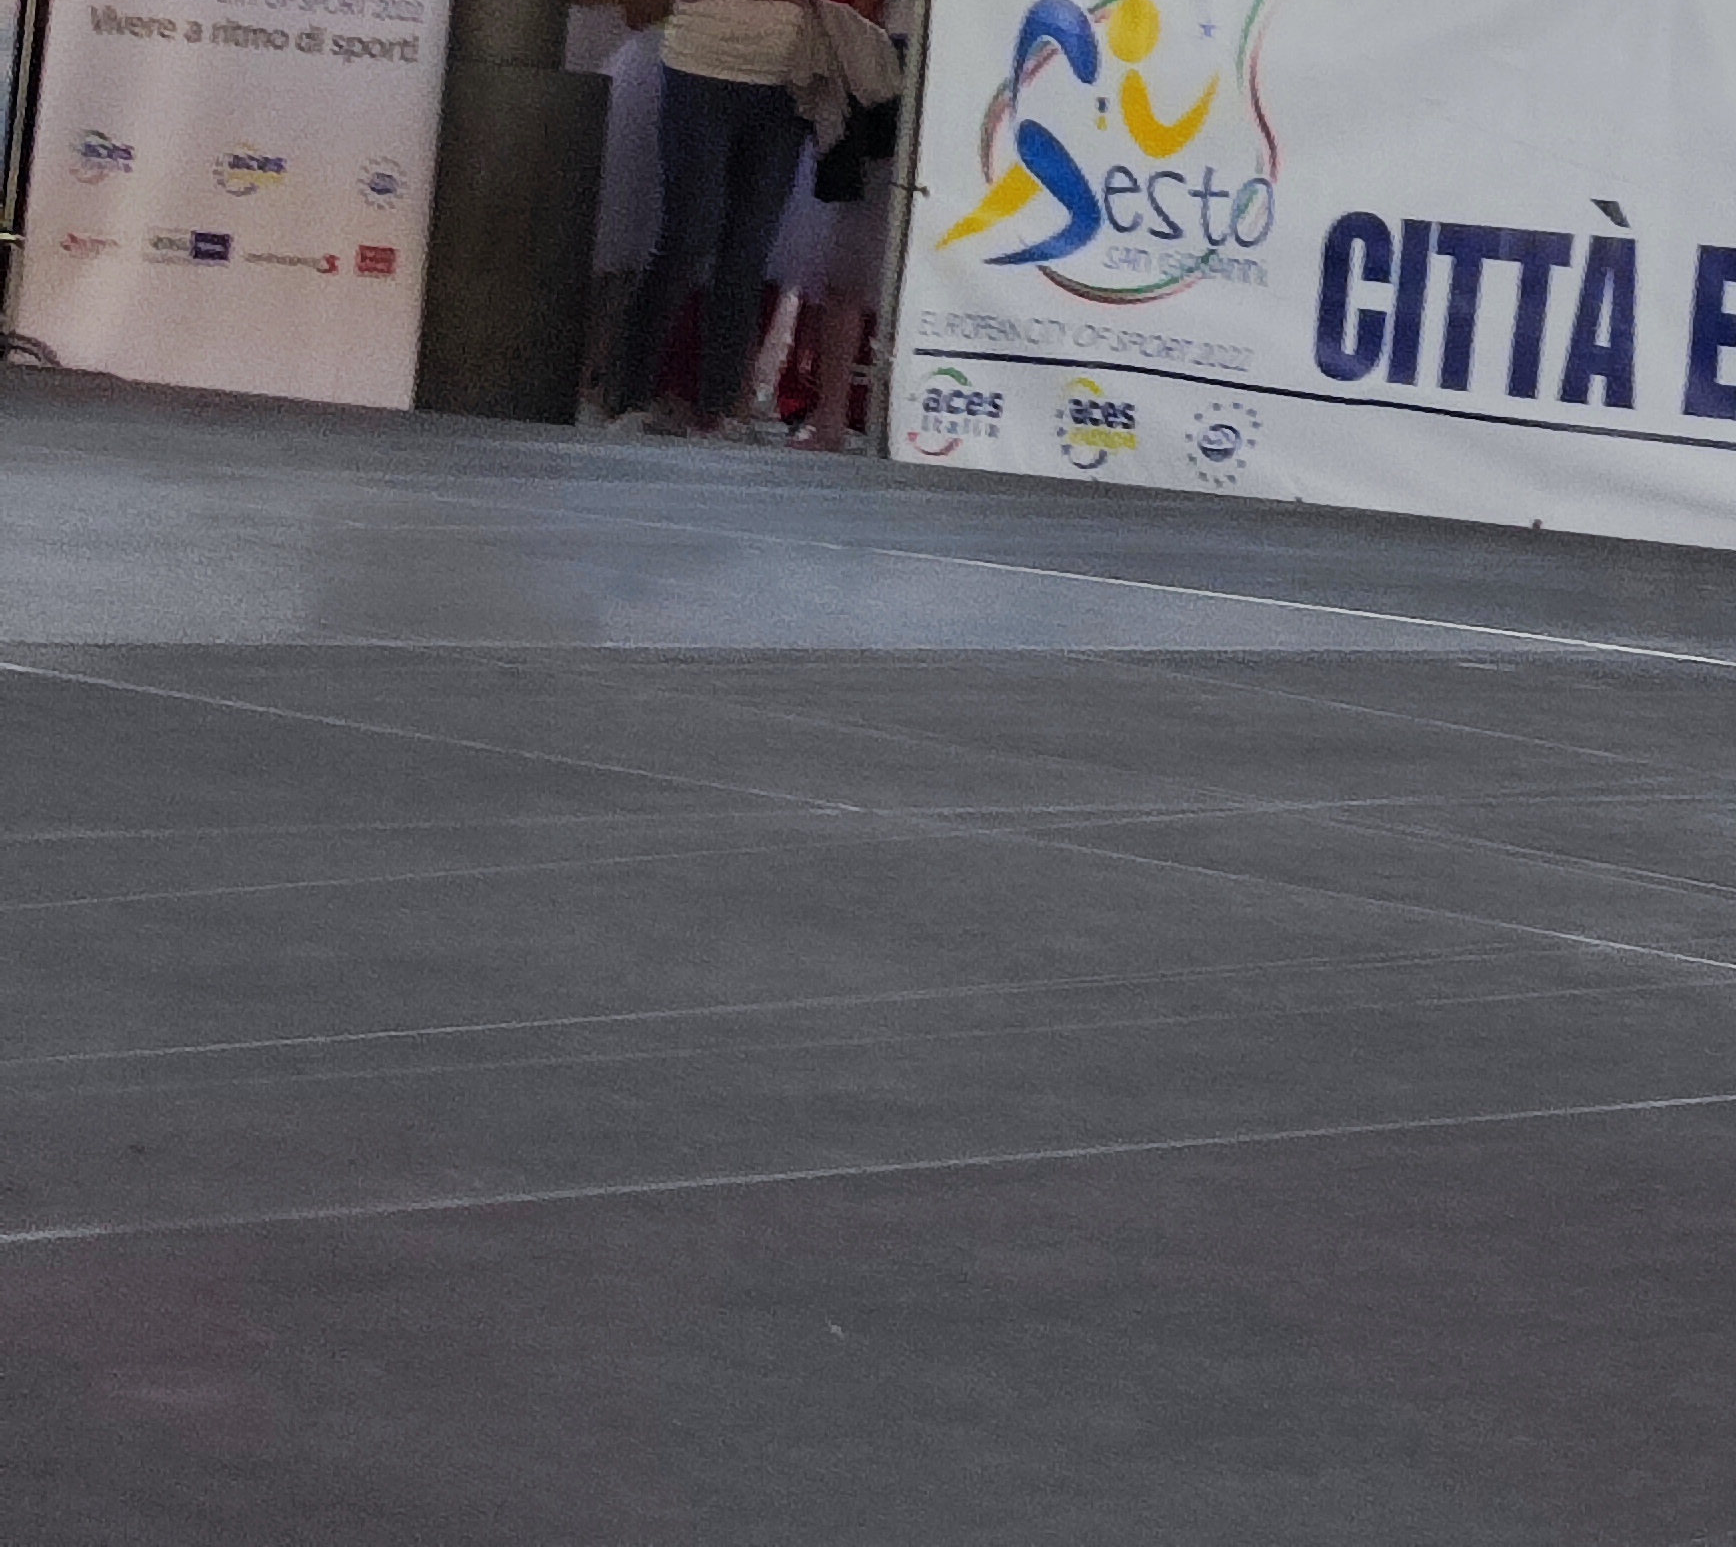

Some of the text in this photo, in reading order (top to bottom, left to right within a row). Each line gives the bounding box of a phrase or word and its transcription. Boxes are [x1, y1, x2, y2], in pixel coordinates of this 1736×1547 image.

[1313, 197, 1638, 411] CITTÀ
[921, 387, 1006, 420] aces
[1067, 397, 1137, 430] aces
